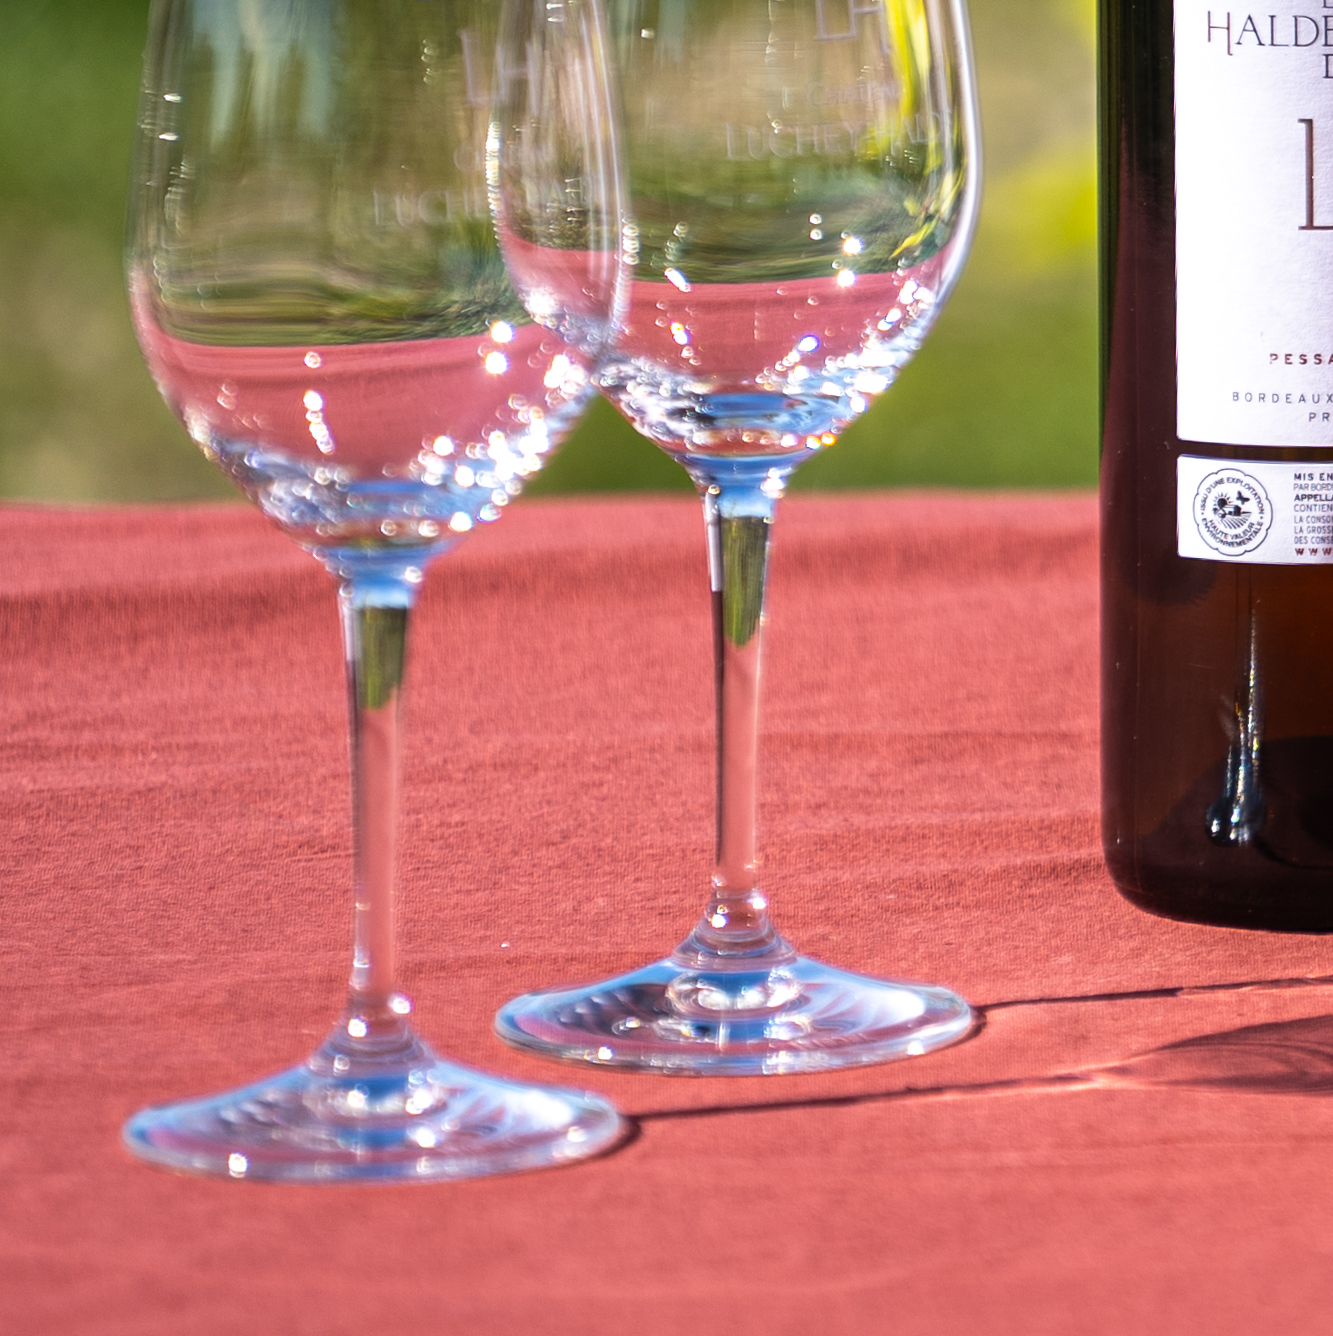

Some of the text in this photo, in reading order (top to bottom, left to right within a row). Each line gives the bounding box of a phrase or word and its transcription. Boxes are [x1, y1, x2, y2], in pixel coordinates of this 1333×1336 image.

[1232, 391, 1333, 404] BORDEAUX
[1293, 473, 1314, 481] MIS
[1319, 473, 1333, 481] EN
[1293, 483, 1309, 491] PAR
[1294, 515, 1303, 524] LA
[1294, 526, 1303, 534] LA
[1294, 536, 1308, 544] DES
